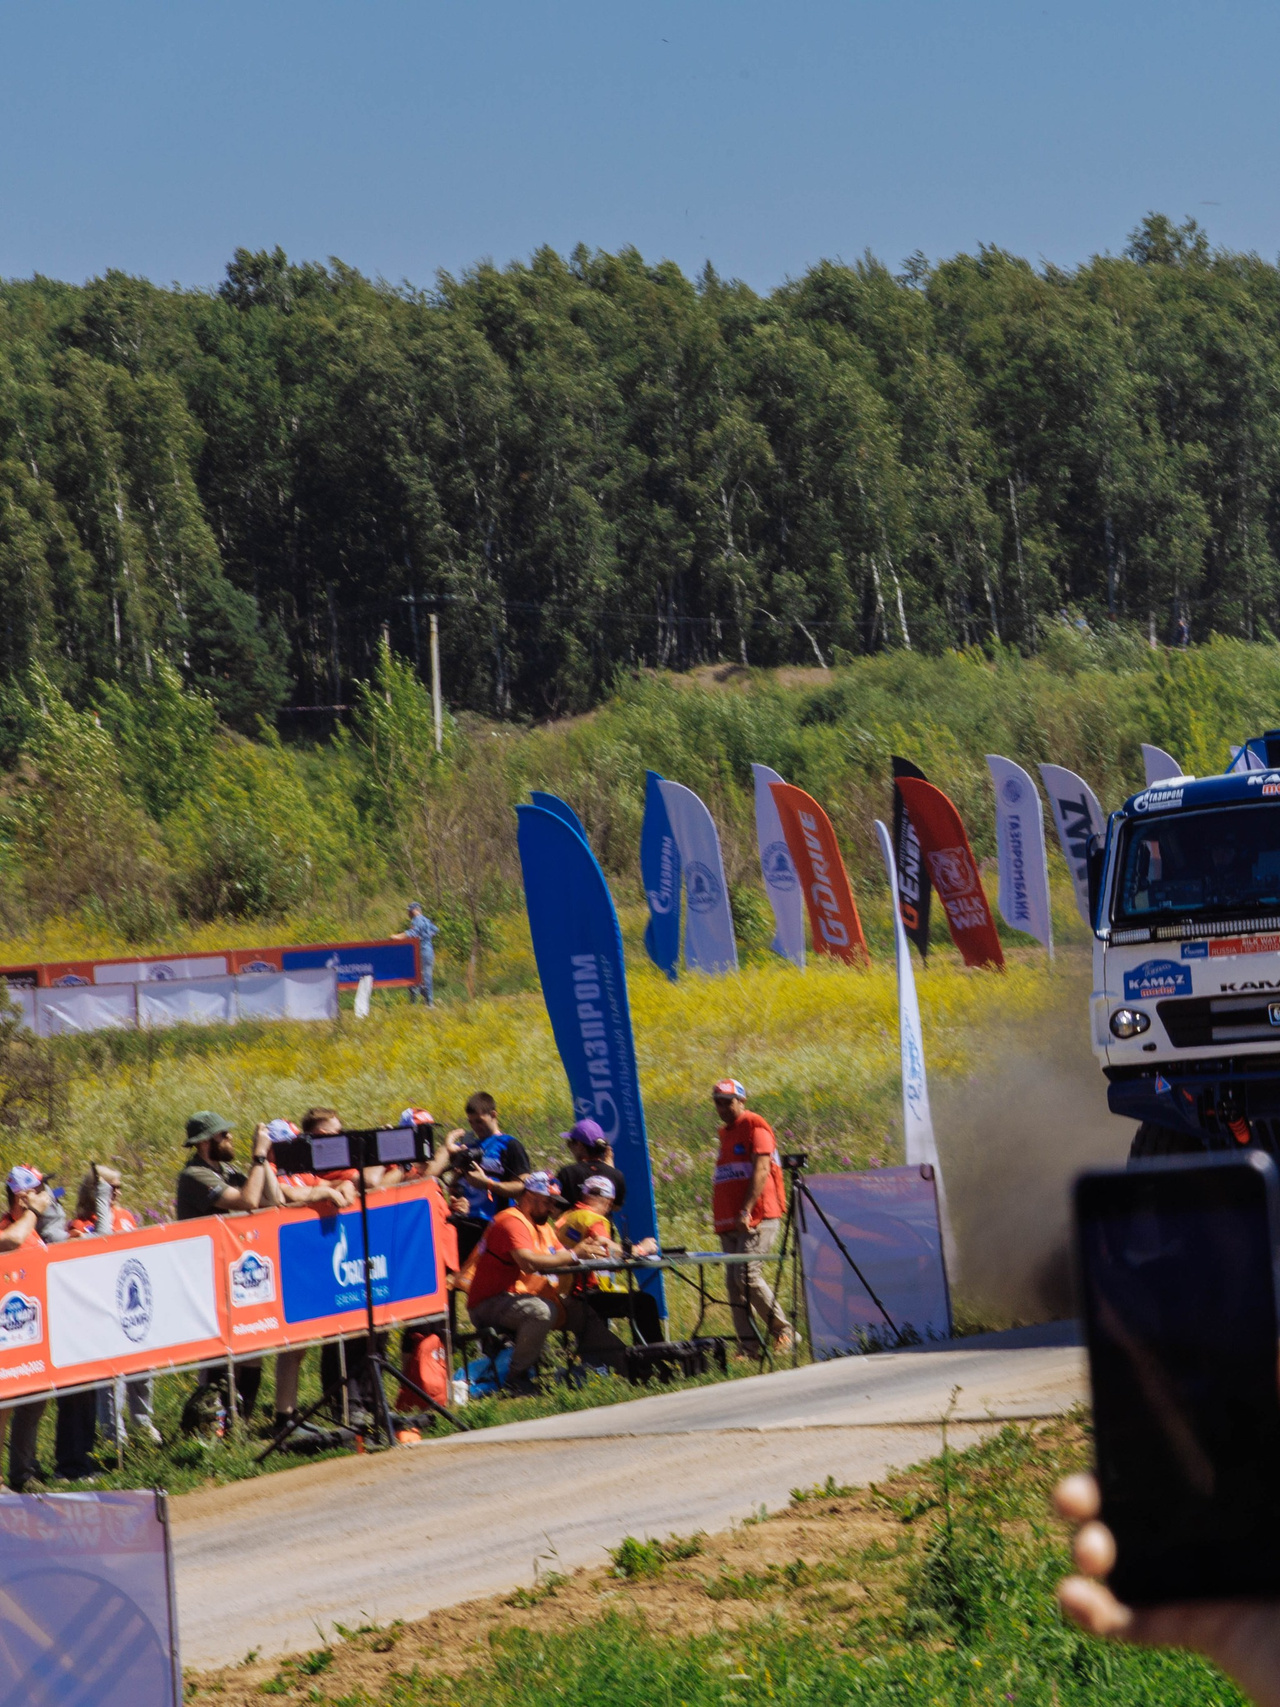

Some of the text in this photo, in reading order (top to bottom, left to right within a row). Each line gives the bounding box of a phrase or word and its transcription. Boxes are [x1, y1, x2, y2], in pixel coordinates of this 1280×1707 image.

[1149, 788, 1184, 803] ГАЗПРОМ
[659, 835, 674, 893] ГАЗПРОМ
[1007, 814, 1030, 922] ГАЗПРОМБАНК
[946, 896, 984, 916] SILK
[951, 910, 988, 930] WAY
[1128, 974, 1186, 990] KAMAZ
[1141, 985, 1176, 998] master
[569, 953, 613, 1090] ГАЗПРОМ
[600, 953, 641, 1146] ГЕНЕРАЛЬНЫЙ ПАРТНЕР
